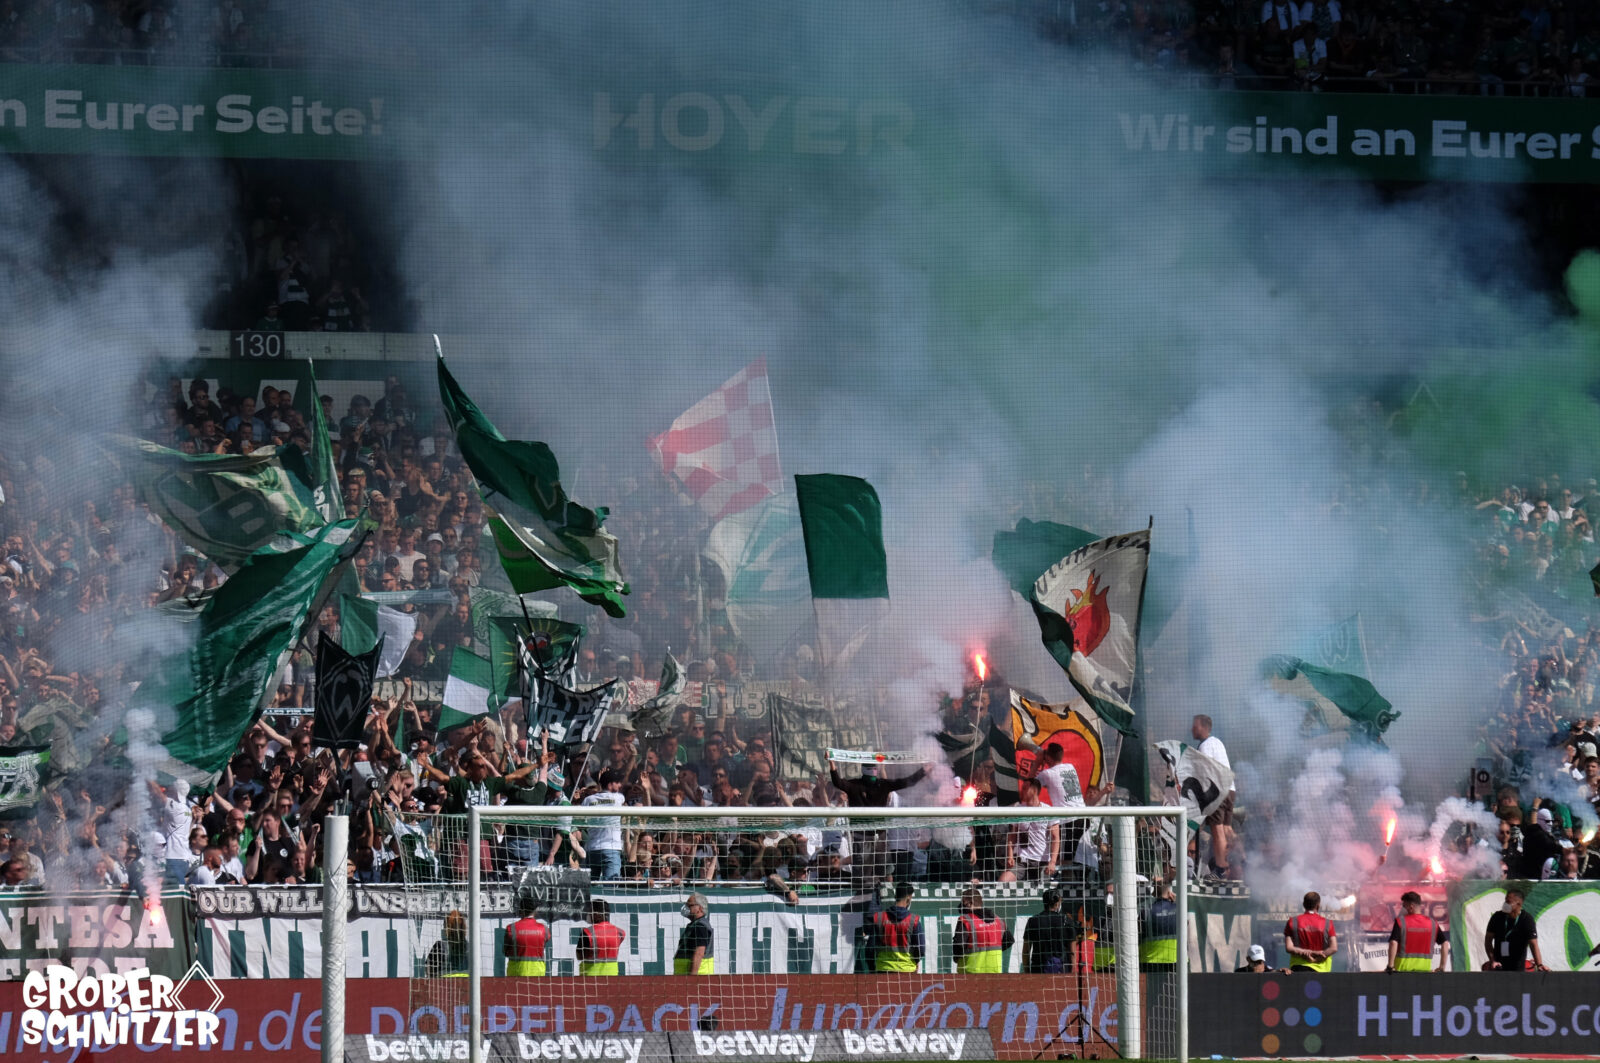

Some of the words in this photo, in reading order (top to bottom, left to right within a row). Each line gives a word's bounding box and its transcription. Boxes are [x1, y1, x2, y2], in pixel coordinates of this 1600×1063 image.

[45, 90, 205, 132] Eurer
[216, 94, 386, 136] Seite!
[592, 91, 918, 156] HOYER
[1117, 112, 1215, 153] Wir
[1226, 115, 1338, 156] sind
[1351, 127, 1416, 157] an
[1431, 119, 1582, 160] Eurer
[234, 333, 281, 358] 130
[536, 871, 563, 885] RIP
[198, 891, 254, 914] OUR
[258, 891, 323, 913] WILL
[365, 1032, 493, 1062] betway
[517, 1032, 643, 1062] betway
[693, 1030, 818, 1062] betway
[843, 1028, 967, 1061] betway
